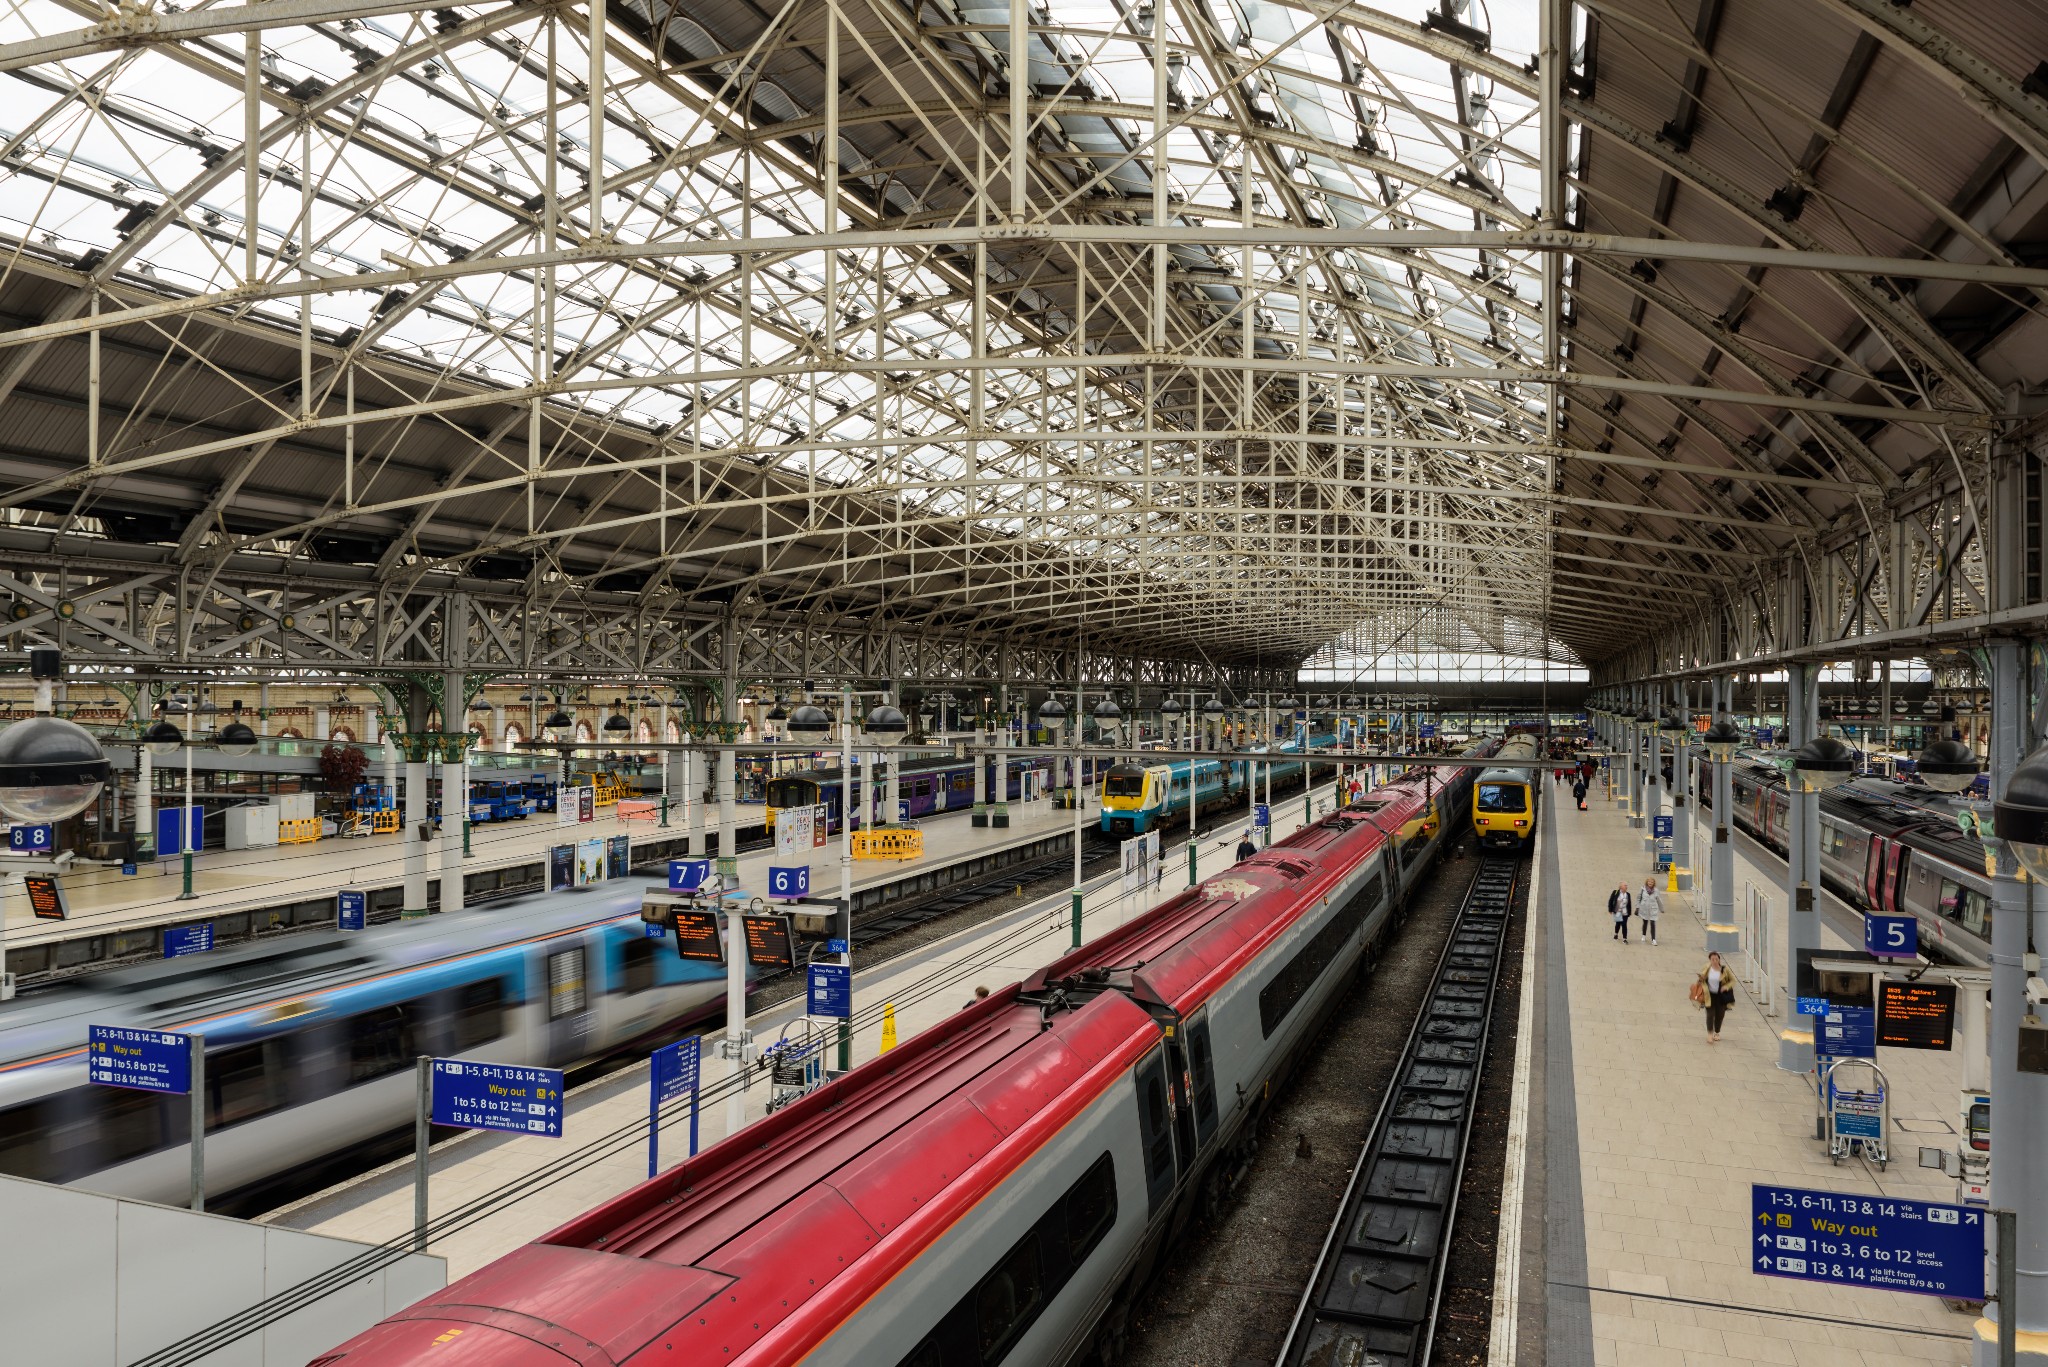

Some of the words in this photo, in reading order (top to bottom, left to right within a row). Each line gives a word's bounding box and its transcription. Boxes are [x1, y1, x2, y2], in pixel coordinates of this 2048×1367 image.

[15, 830, 23, 845] 8
[34, 829, 44, 844] 8
[677, 866, 687, 883] 7
[698, 865, 705, 882] 7
[776, 872, 788, 890] 6
[799, 871, 805, 889] 6
[1867, 919, 1872, 942] 5
[1887, 923, 1905, 946] 5
[1804, 1005, 1823, 1013] 364
[126, 1032, 133, 1040] 13
[142, 1034, 150, 1042] 14
[113, 1045, 128, 1056] Way
[118, 1060, 125, 1068] to
[126, 1061, 132, 1070] 5,
[140, 1063, 147, 1071] to
[149, 1063, 156, 1072] 12
[114, 1074, 120, 1082] 13
[122, 1075, 128, 1083] &
[129, 1075, 137, 1084] 14
[505, 1070, 514, 1079] 13
[516, 1071, 523, 1080] &
[526, 1071, 535, 1081] 14
[489, 1084, 508, 1096] Way
[510, 1088, 526, 1096] out
[454, 1097, 458, 1106] 1
[459, 1098, 468, 1107] to
[470, 1098, 478, 1109] 5,
[480, 1099, 486, 1108] 8
[488, 1100, 498, 1110] to
[500, 1101, 509, 1111] 12
[453, 1112, 462, 1122] 13
[464, 1114, 471, 1123] &
[473, 1115, 482, 1124] 14
[1841, 1199, 1857, 1213] 13
[1861, 1202, 1874, 1215] &
[1878, 1203, 1896, 1217] 14
[1900, 1212, 1922, 1220] stairs
[1811, 1218, 1845, 1236] Way
[1850, 1225, 1878, 1238] out
[1811, 1239, 1817, 1253] 1
[1821, 1241, 1837, 1255] to
[1842, 1243, 1855, 1258] 3,
[1860, 1245, 1870, 1258] 6
[1874, 1247, 1890, 1261] to
[1895, 1249, 1911, 1263] 12
[1916, 1250, 1935, 1259] level
[1916, 1258, 1943, 1267] access
[1811, 1261, 1827, 1275] 13
[1831, 1264, 1843, 1277] &
[1848, 1266, 1866, 1280] 14
[1883, 1268, 1895, 1278] lift
[1896, 1270, 1916, 1279] from
[1870, 1274, 1908, 1286] platforms
[1910, 1278, 1925, 1287] 8/9
[1926, 1280, 1934, 1288] &
[1936, 1281, 1945, 1290] 10
